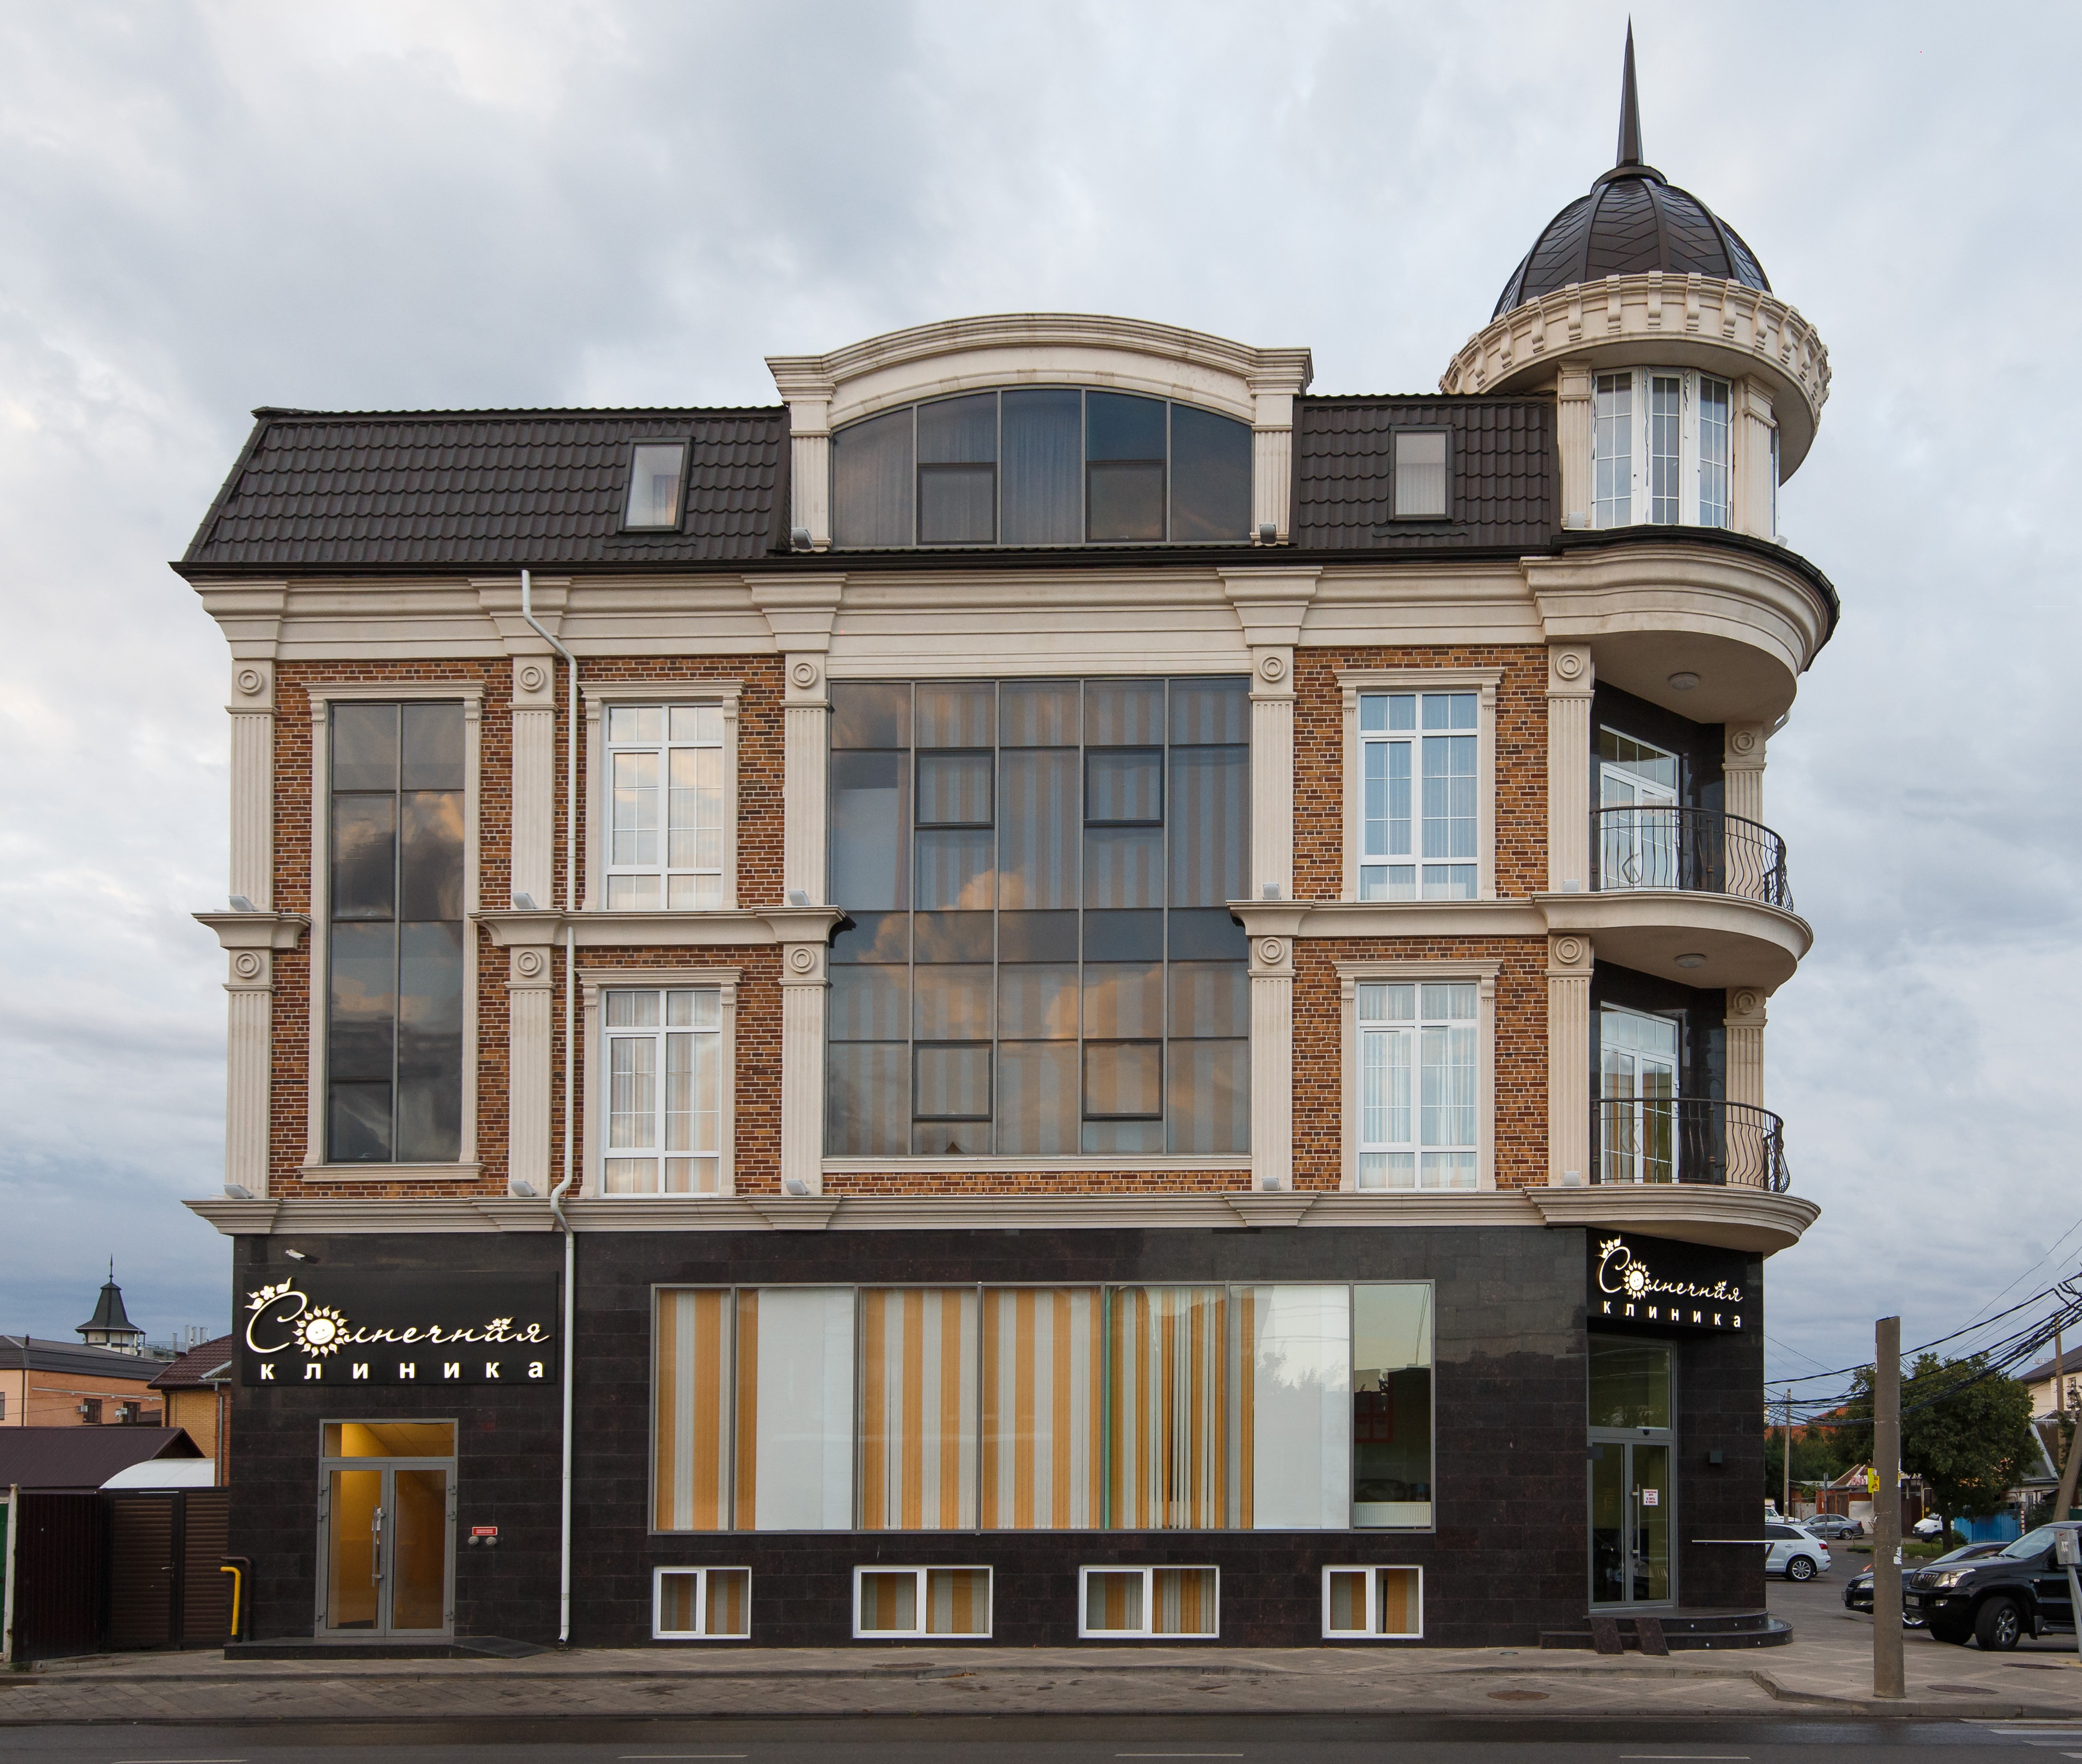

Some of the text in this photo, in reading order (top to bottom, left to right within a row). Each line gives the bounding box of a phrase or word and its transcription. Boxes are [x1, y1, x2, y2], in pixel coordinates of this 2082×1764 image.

[1598, 1240, 1744, 1302] Солнечная
[245, 1286, 550, 1356] Солнечная
[1603, 1300, 1741, 1328] клиника
[260, 1361, 544, 1380] клиника
